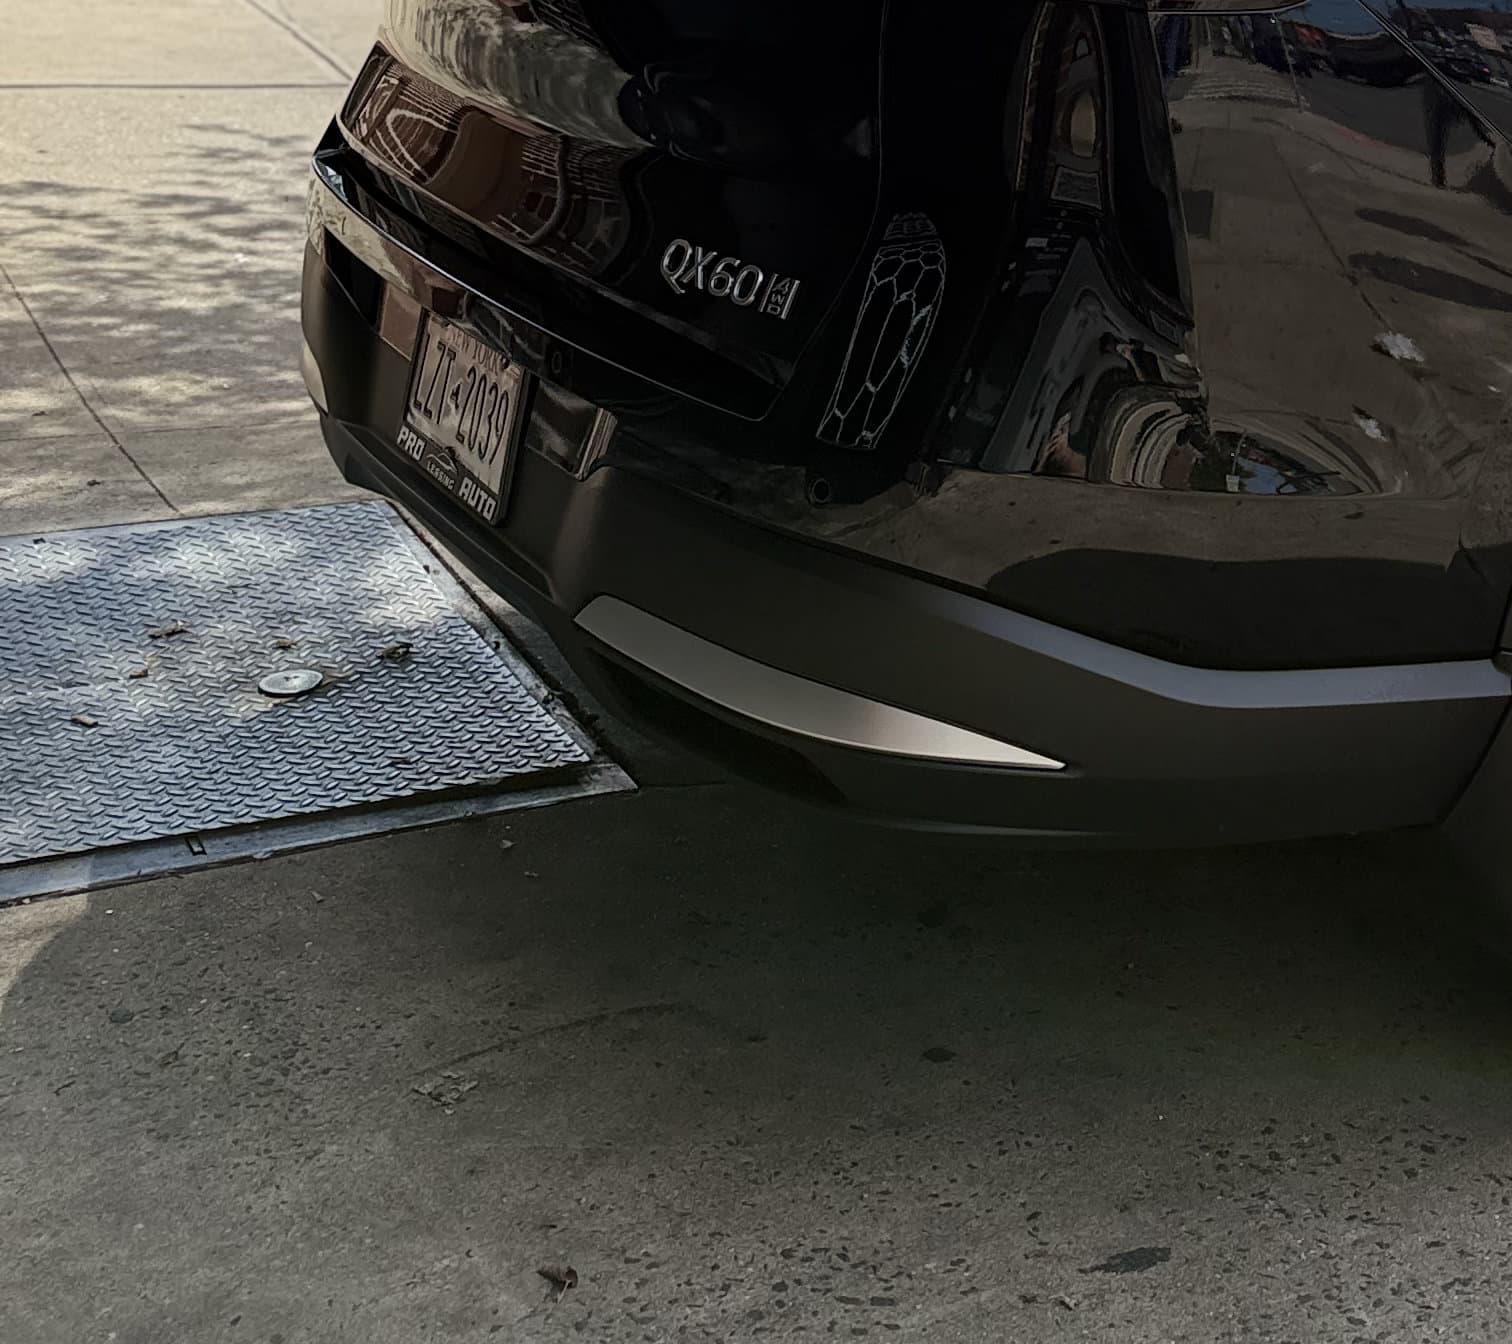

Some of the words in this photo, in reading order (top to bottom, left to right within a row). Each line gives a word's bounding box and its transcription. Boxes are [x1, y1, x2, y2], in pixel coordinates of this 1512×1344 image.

[660, 238, 764, 307] QX60
[469, 341, 500, 379] YORK
[455, 364, 510, 466] 2039
[395, 424, 427, 462] PRO
[458, 476, 498, 522] AUTO
